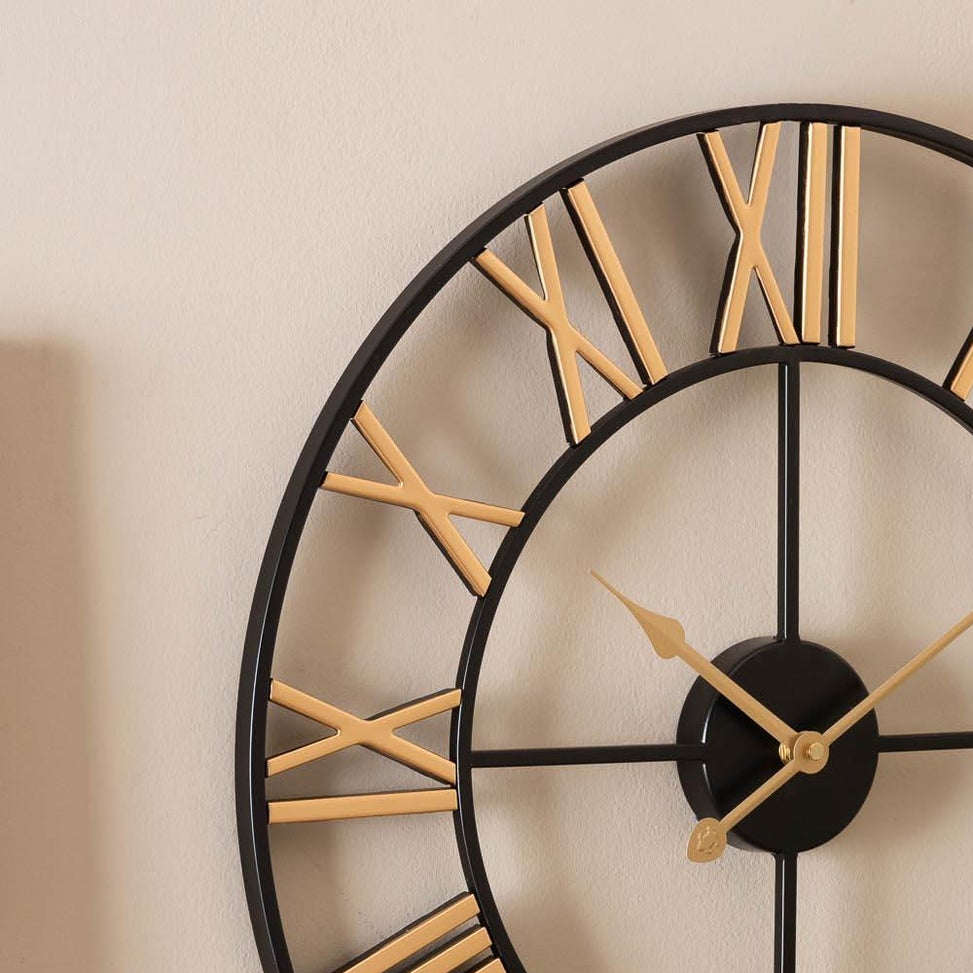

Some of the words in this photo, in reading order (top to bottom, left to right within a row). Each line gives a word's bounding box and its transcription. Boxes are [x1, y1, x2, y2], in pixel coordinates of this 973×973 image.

[468, 178, 667, 447] XI
[697, 120, 861, 355] XII
[318, 399, 526, 599] X
[266, 677, 463, 824] IX
